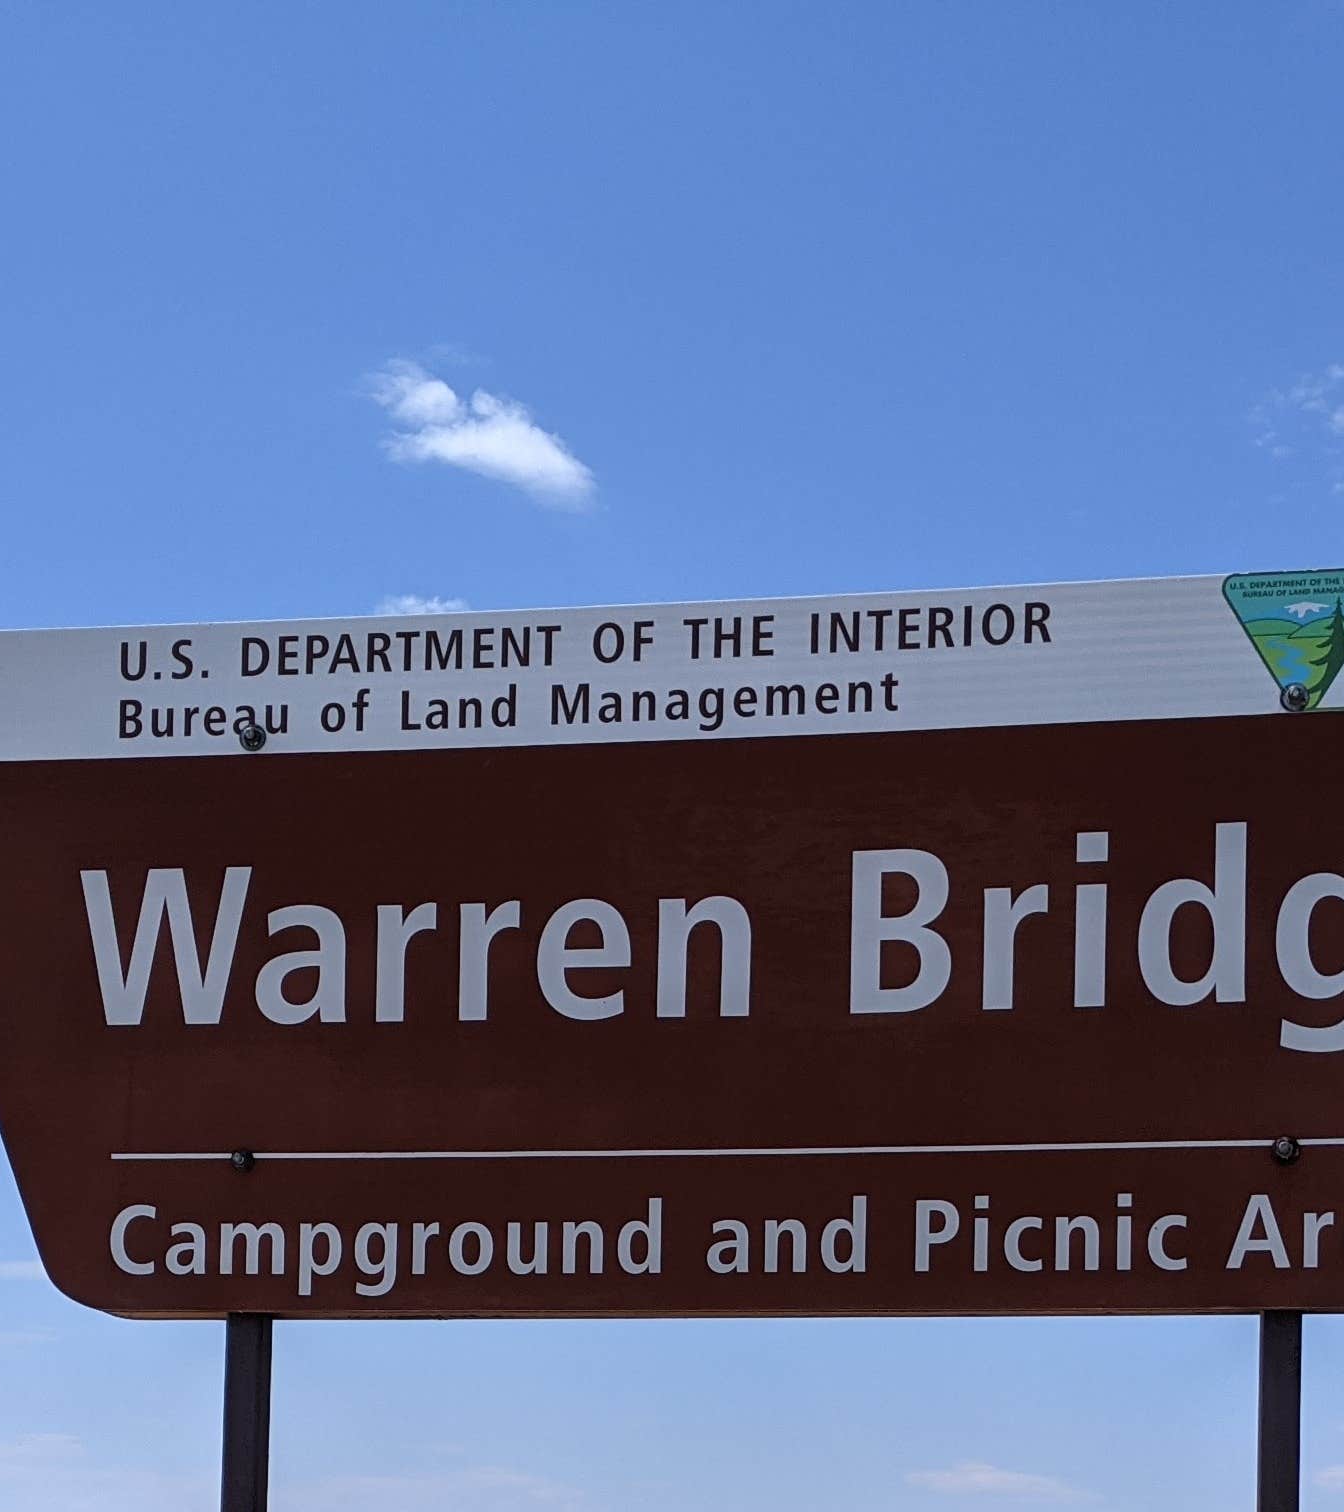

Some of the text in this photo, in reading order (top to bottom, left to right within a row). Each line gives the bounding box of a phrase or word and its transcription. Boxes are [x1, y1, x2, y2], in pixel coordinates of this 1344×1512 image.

[1242, 590, 1274, 598] BUREAU
[1249, 579, 1307, 589] DEPARTMENT
[1309, 578, 1321, 586] OF
[1324, 577, 1340, 586] THE
[120, 601, 1052, 682] U.S. DEPARTMENT OF THE INTERIOR
[118, 672, 899, 739] Bureau of Land Management
[79, 866, 752, 1026] Warren
[110, 1197, 662, 1297] Campground
[706, 1195, 867, 1274] and
[914, 1193, 1188, 1272] Picnic
